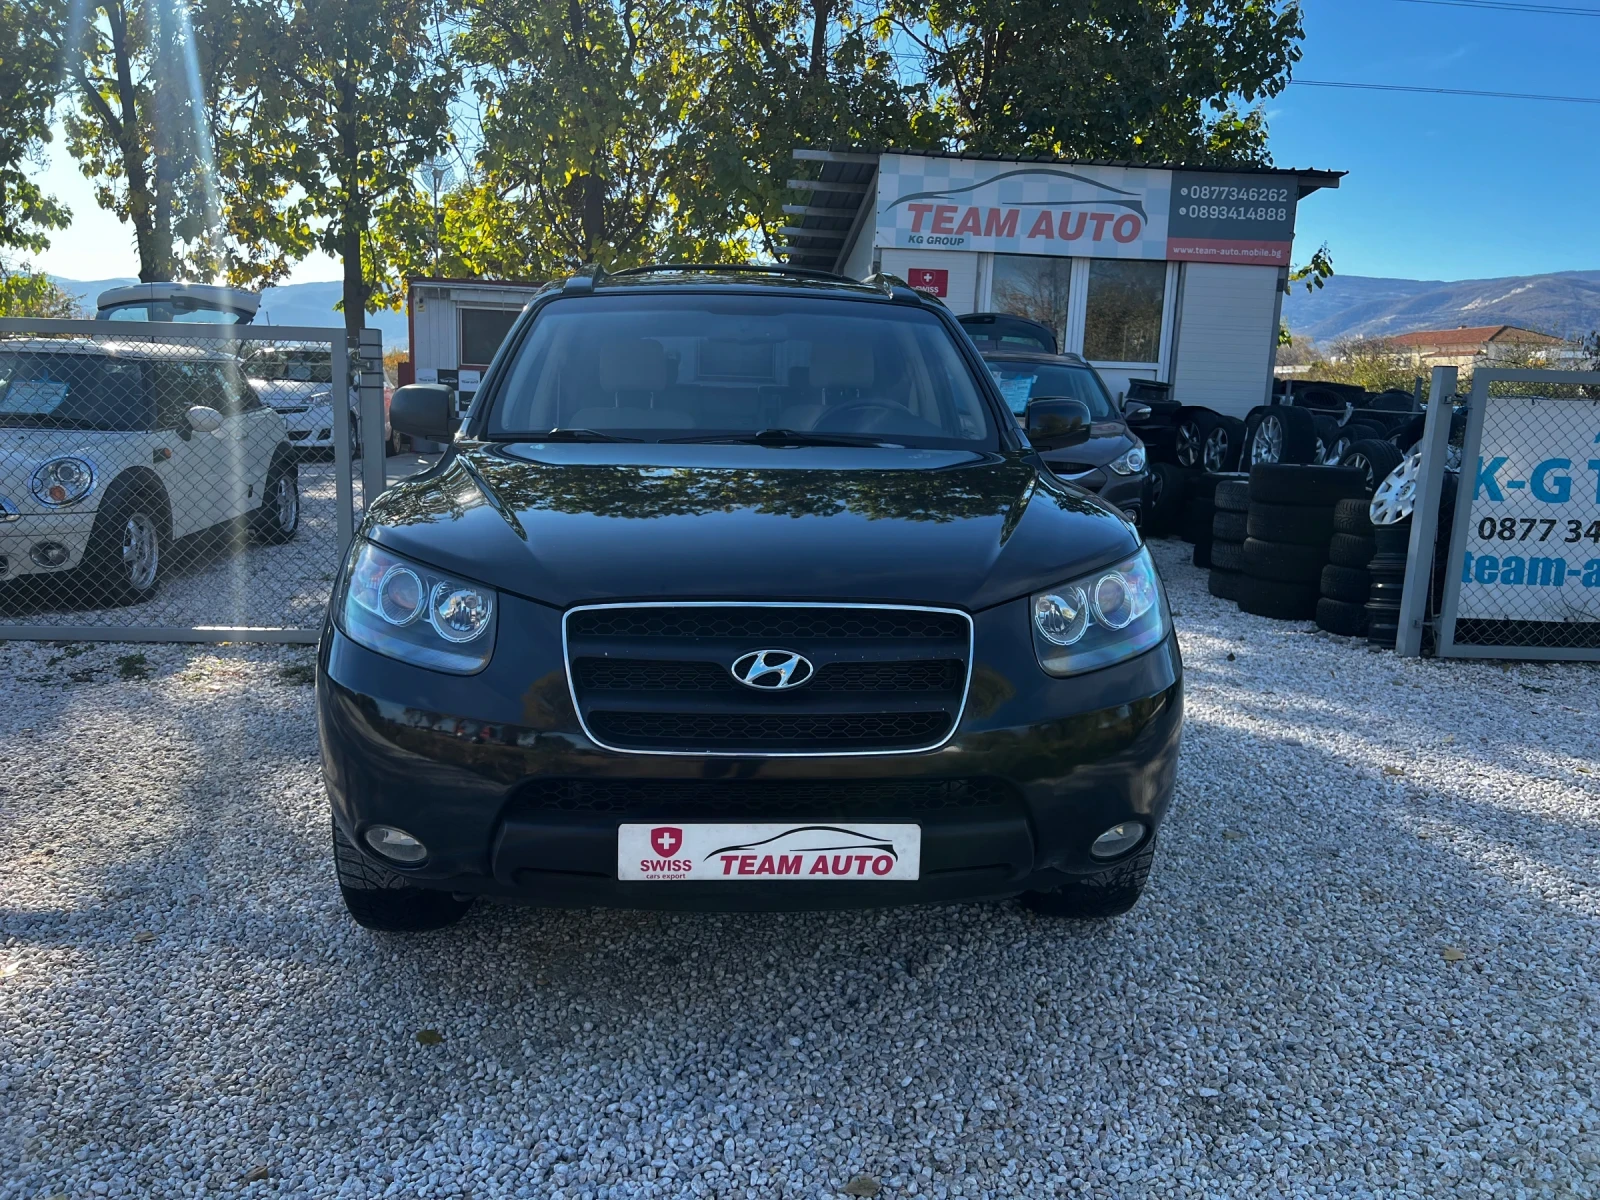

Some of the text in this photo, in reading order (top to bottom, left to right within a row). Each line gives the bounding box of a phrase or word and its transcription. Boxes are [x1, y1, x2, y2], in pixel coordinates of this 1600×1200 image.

[1190, 185, 1288, 202] 0877346262
[1189, 205, 1287, 221] 0893414888
[907, 203, 1142, 244] TEAM AUTO
[908, 235, 965, 246] KG GROUP
[1173, 246, 1282, 259] www.team-auto.mobile.bg
[1478, 517, 1600, 543] 0877 34
[640, 854, 894, 876] SWISS TEAM AUTO
